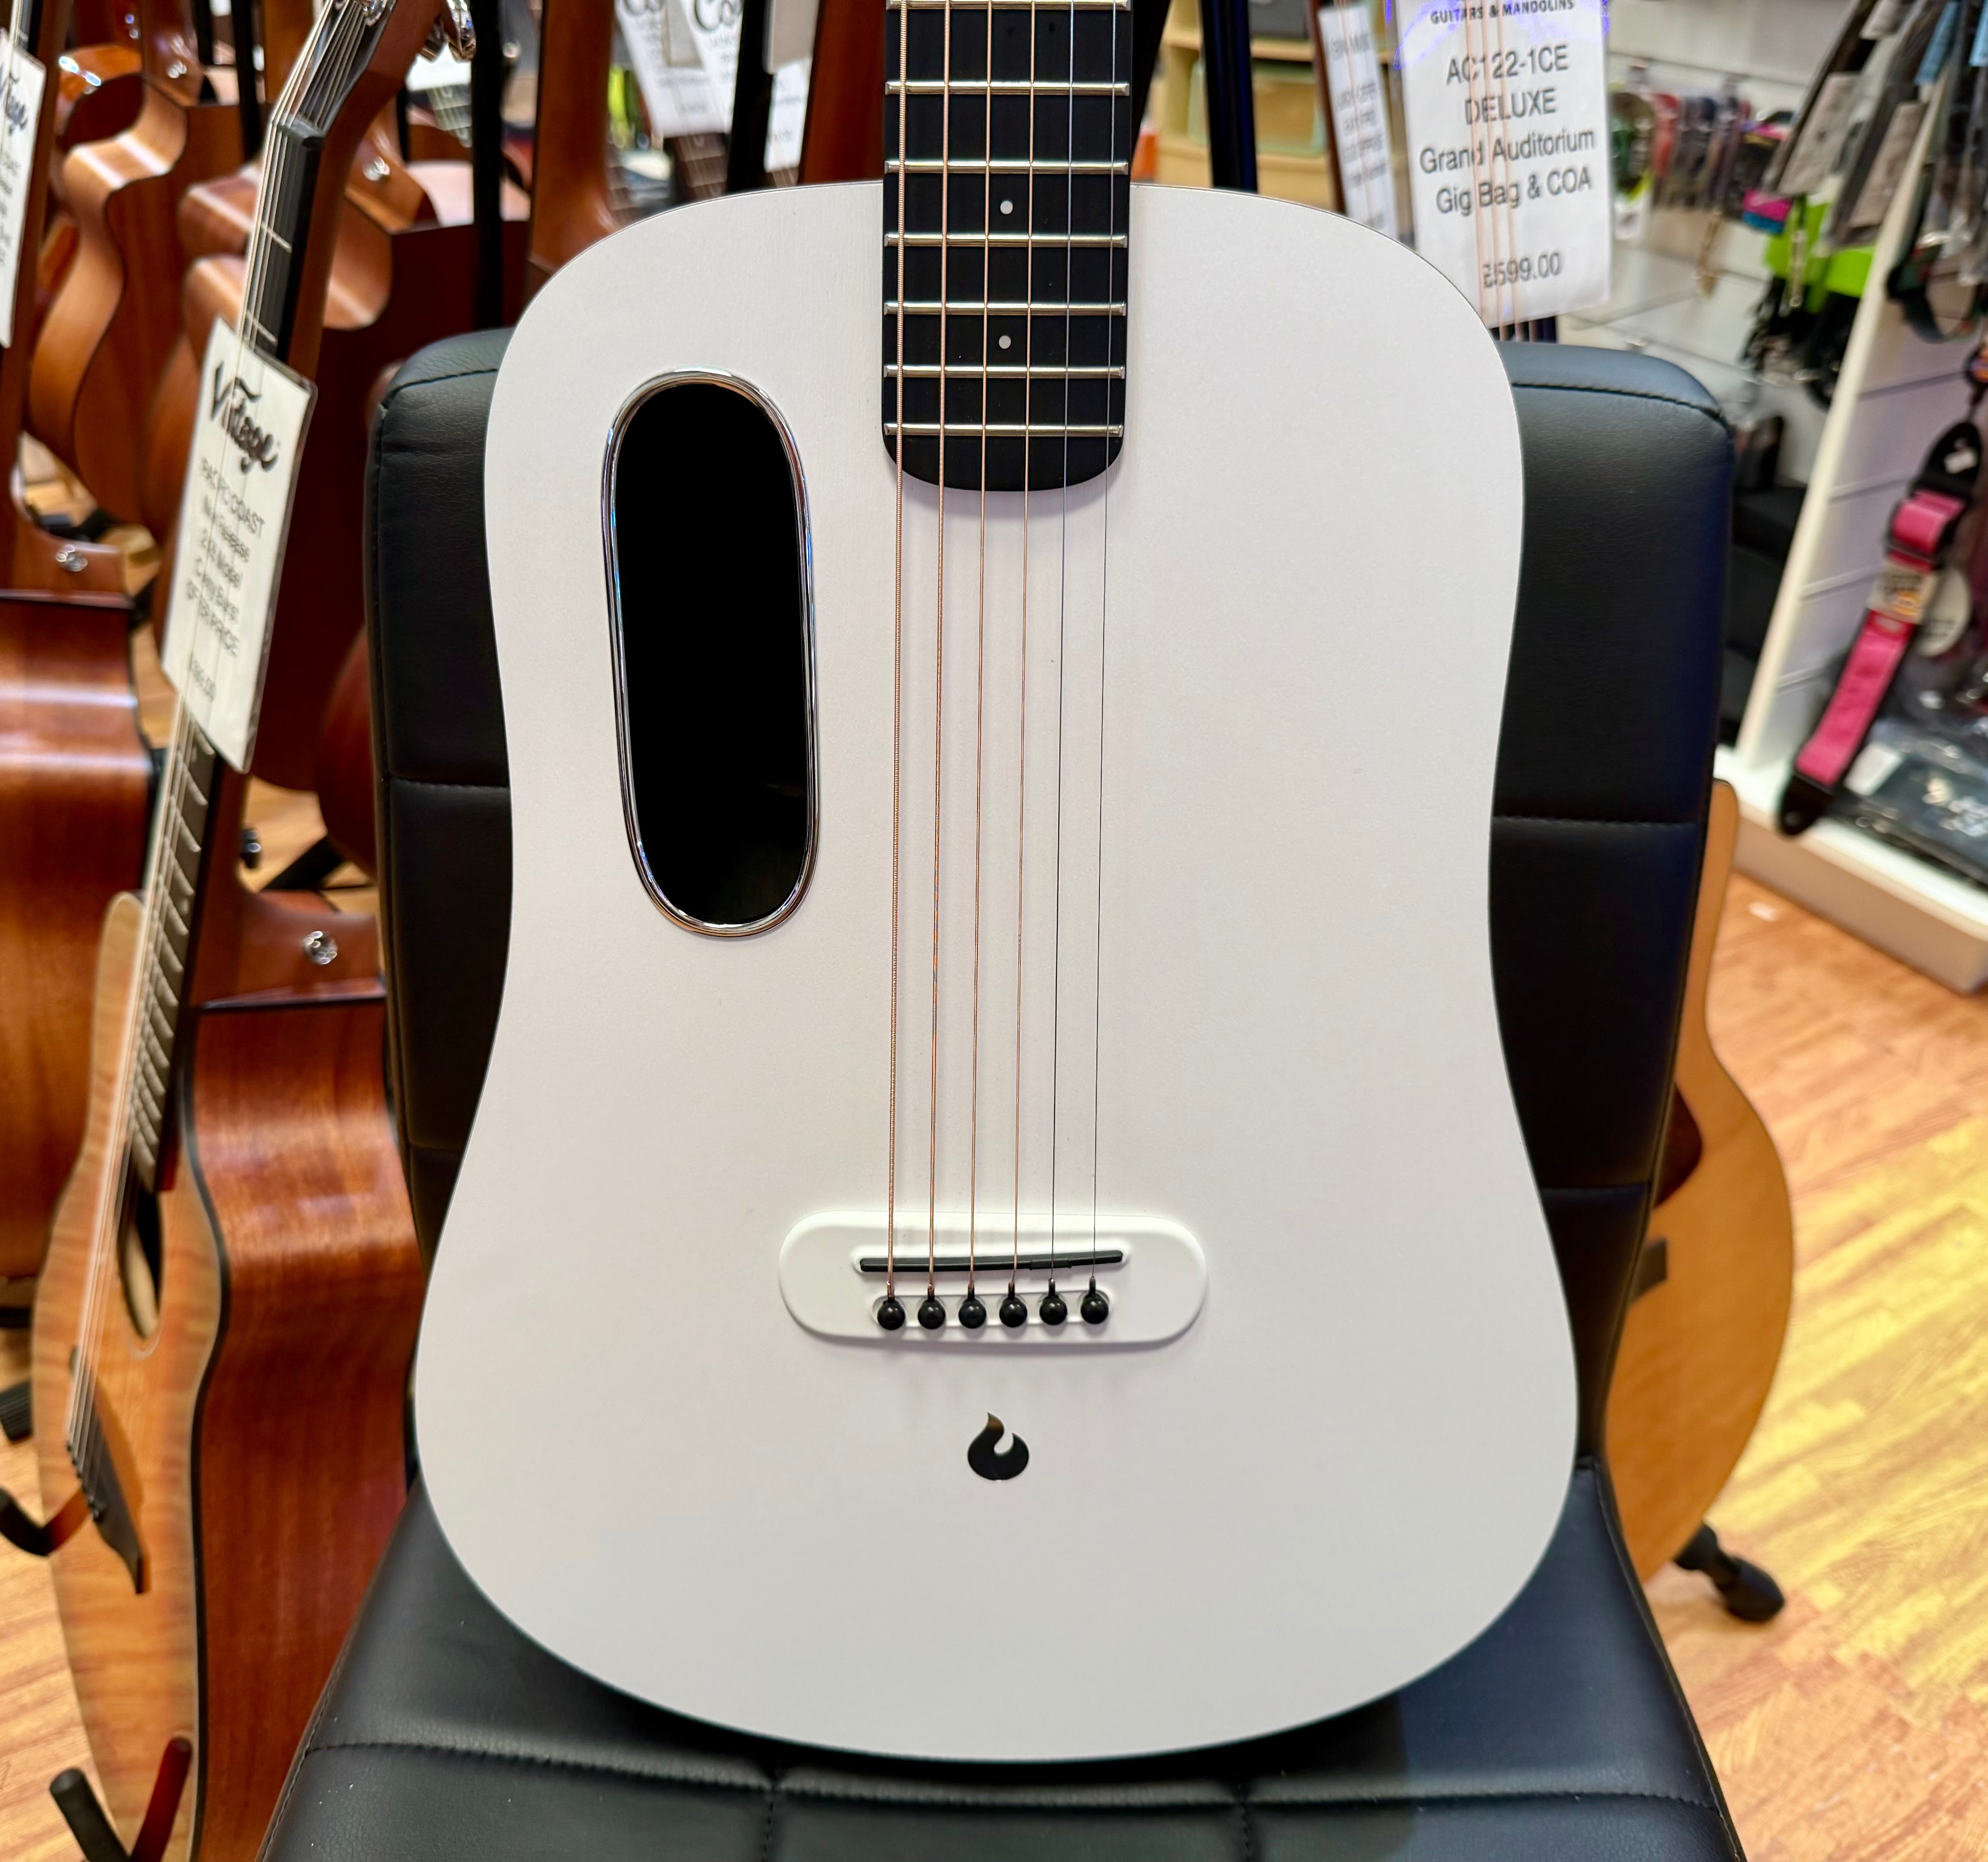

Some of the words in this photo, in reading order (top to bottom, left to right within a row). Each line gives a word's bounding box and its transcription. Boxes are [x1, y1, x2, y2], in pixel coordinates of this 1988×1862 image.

[1430, 7, 1483, 24] GUITARS
[1489, 5, 1499, 18] &
[1502, 0, 1575, 17] MANDOLINS
[1464, 88, 1557, 125] DELUXE
[1420, 140, 1484, 173] Grand
[1492, 129, 1595, 162] Auditorium
[1436, 186, 1473, 216] Gig
[1478, 182, 1521, 208] Bag
[1527, 174, 1541, 200] &
[1546, 166, 1592, 196] COA
[211, 361, 278, 474] Vintage
